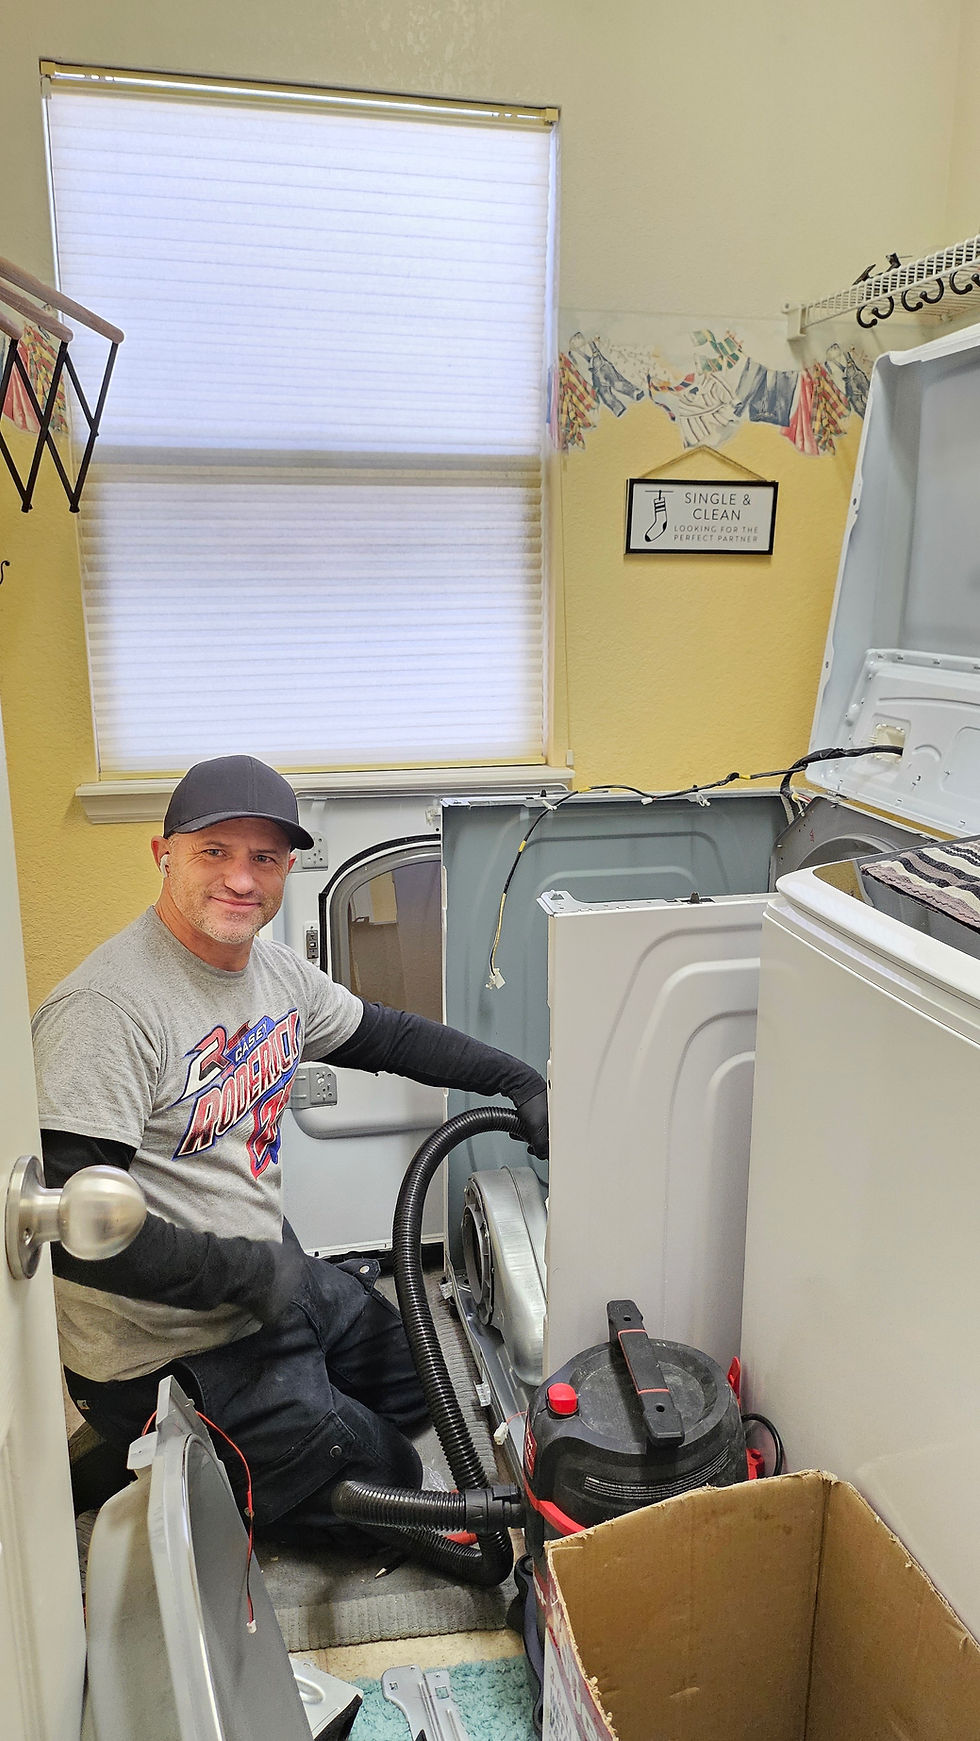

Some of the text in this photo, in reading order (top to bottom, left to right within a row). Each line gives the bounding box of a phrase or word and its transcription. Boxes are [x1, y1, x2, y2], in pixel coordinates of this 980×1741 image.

[685, 492, 752, 505] SINGLE &
[693, 508, 741, 521] CLEAN
[674, 525, 758, 534] LOOKING FOR THE
[235, 1021, 269, 1062] CASEY
[176, 1010, 299, 1157] RODERICK
